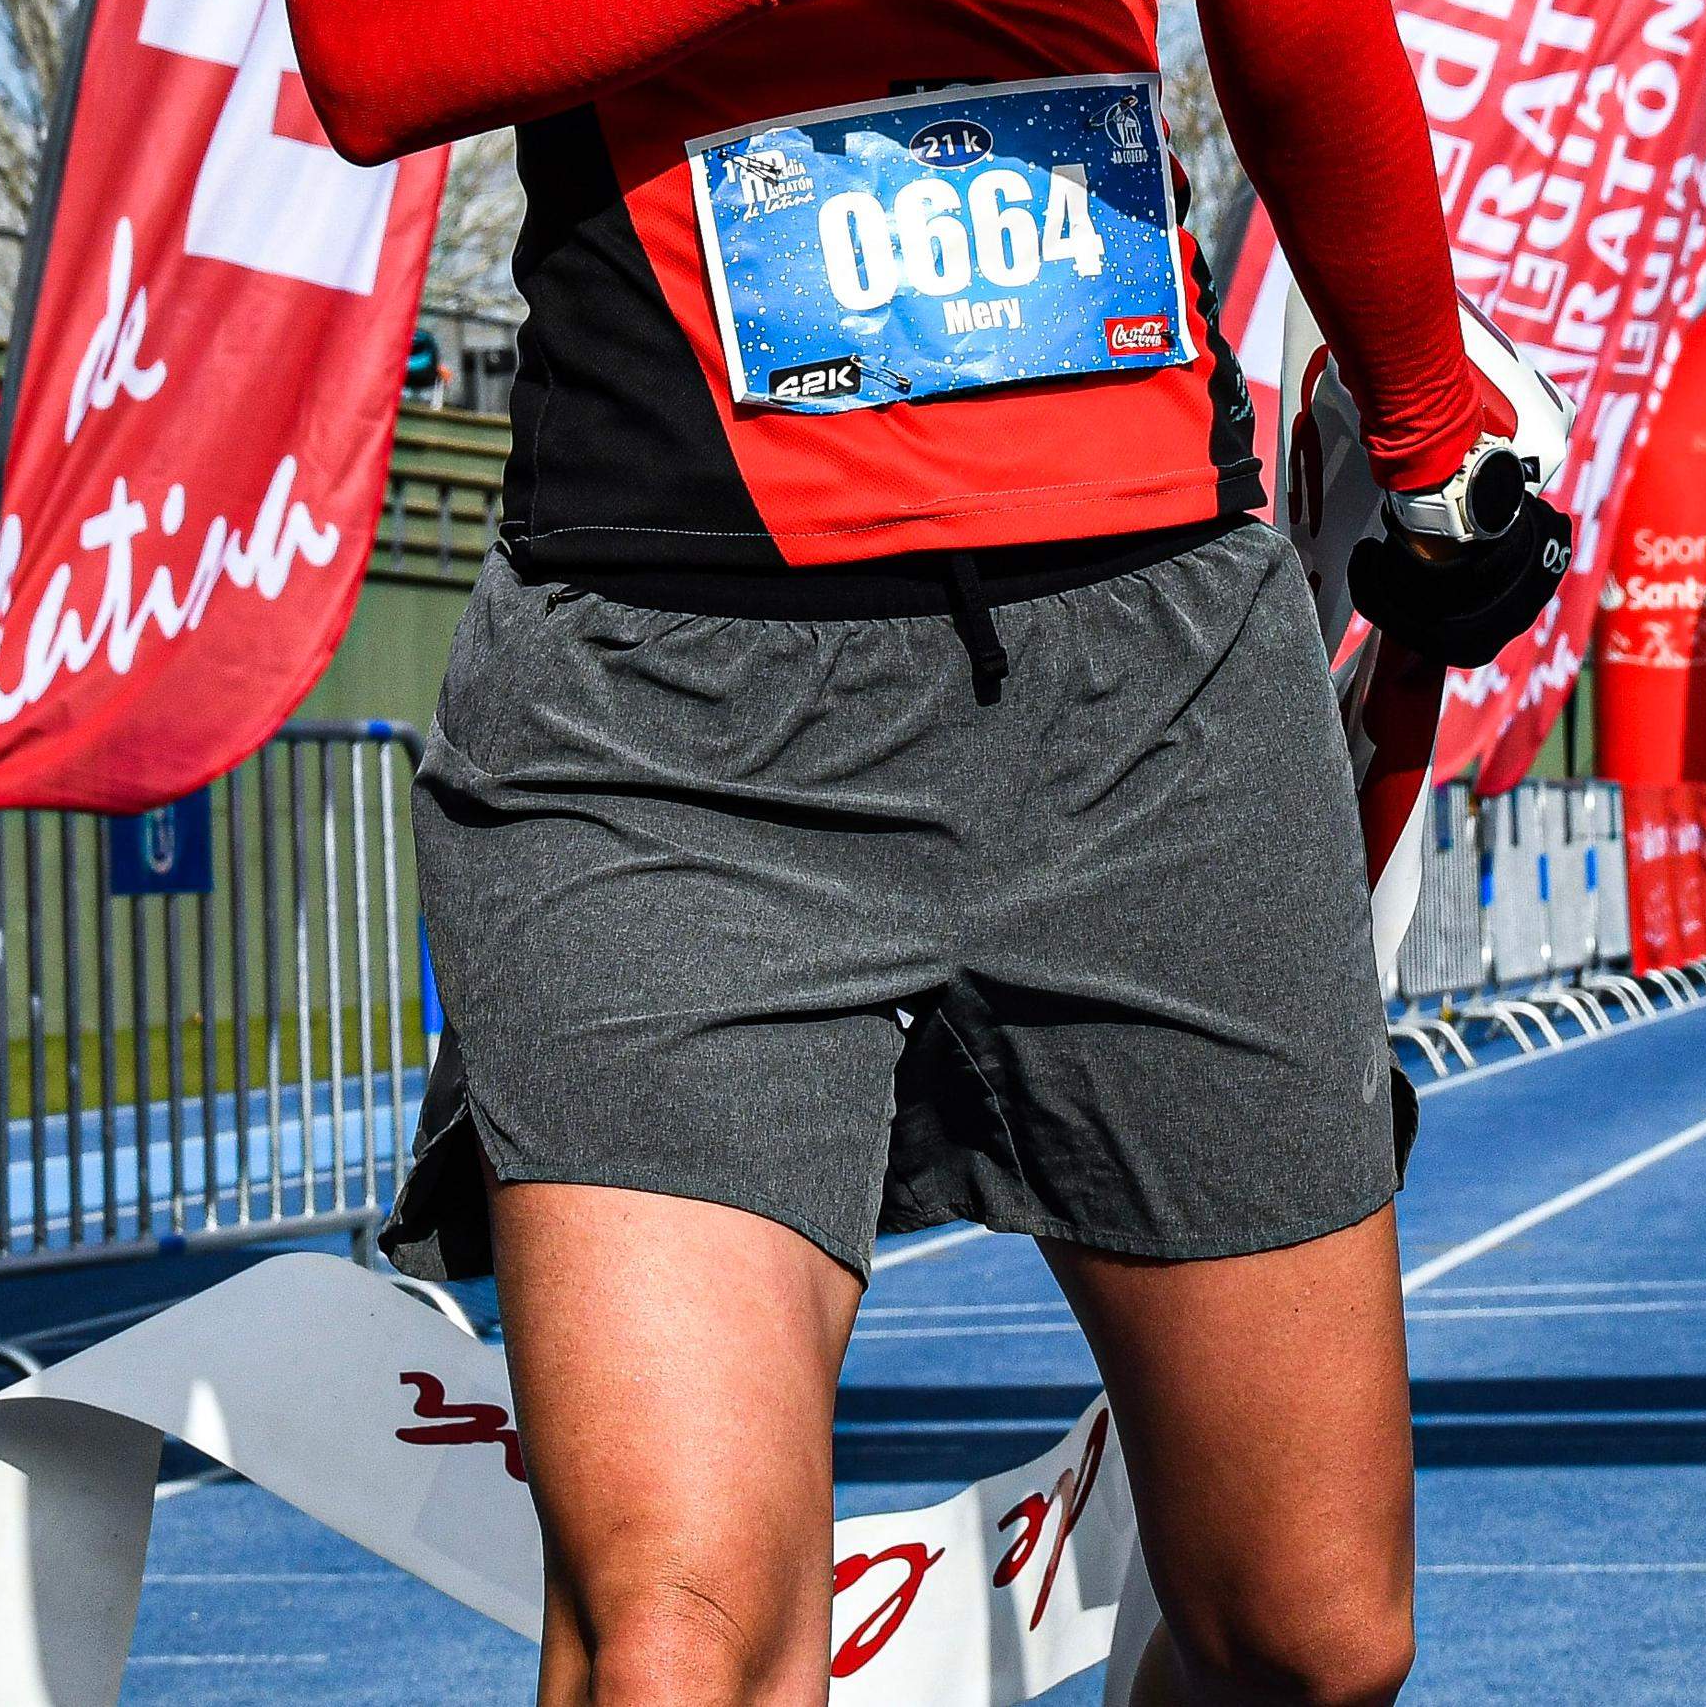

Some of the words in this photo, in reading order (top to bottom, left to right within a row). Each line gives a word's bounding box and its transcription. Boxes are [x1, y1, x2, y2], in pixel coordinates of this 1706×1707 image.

[923, 133, 956, 159] 21
[818, 163, 1106, 312] 0664
[941, 297, 1024, 336] Mery
[776, 365, 855, 398] 42K
